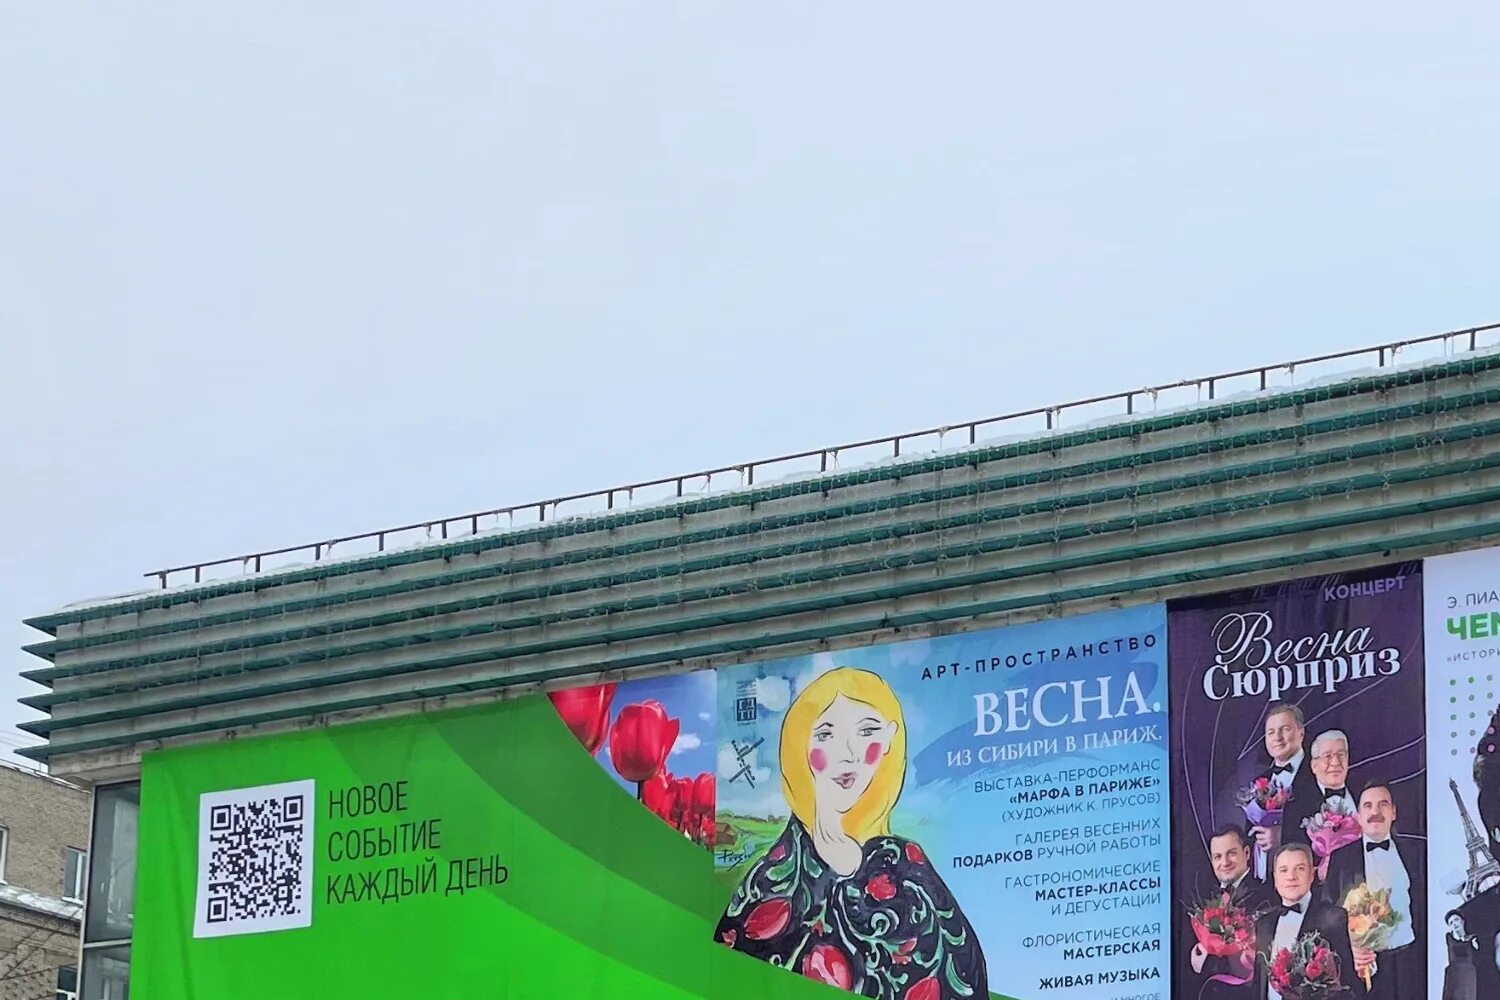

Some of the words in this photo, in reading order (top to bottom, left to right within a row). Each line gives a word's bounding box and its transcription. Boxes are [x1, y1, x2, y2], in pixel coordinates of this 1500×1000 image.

[1324, 575, 1407, 602] КОНЦЕРТ
[1211, 609, 1375, 669] Весна
[921, 634, 1157, 680] АРТ-ПРОСТРАНСТВО
[1203, 648, 1401, 702] Сюрприз
[973, 671, 1161, 737] ВЕСНА.
[947, 751, 972, 767] ИЗ
[978, 738, 1058, 762] СИБИРИ
[1065, 736, 1077, 752] В
[1084, 724, 1162, 749] ПАРИЖ.
[975, 759, 1161, 793] ВЫСТАВКА-ПЕРФОРМАНС
[1009, 786, 1070, 805] «МАРФА
[1075, 785, 1084, 797] В
[1088, 776, 1161, 795] ПАРИЖЕ»
[328, 781, 409, 819] НОВОЕ
[1002, 802, 1082, 822] (ХУДОЖНИК
[1102, 792, 1161, 810] ПРУСОВ)
[328, 819, 442, 862] СОБЫТИЕ
[1015, 828, 1079, 846] ГАЛЕРЕЯ
[1084, 817, 1161, 838] ВЕСЕННИХ
[953, 849, 1033, 868] ПОДАРКОВ
[1037, 839, 1096, 858] РУЧНОЙ
[1101, 834, 1161, 850] РАБОТЫ
[326, 857, 438, 904] КАЖДЫЙ
[445, 854, 509, 896] ДЕНЬ
[1005, 860, 1161, 889] ГАСТРОНОМИЧЕСКИЕ
[1035, 877, 1161, 901] МАСТЕР-КЛАССЫ
[1051, 904, 1061, 915] И
[1065, 893, 1161, 916] ДЕГУСТАЦИИ
[1022, 922, 1161, 948] ФЛОРИСТИЧЕСКАЯ
[1063, 940, 1161, 960] МАСТЕРСКАЯ
[1039, 973, 1093, 990] ЖИВАЯ
[1098, 967, 1161, 984] МУЗЫКА
